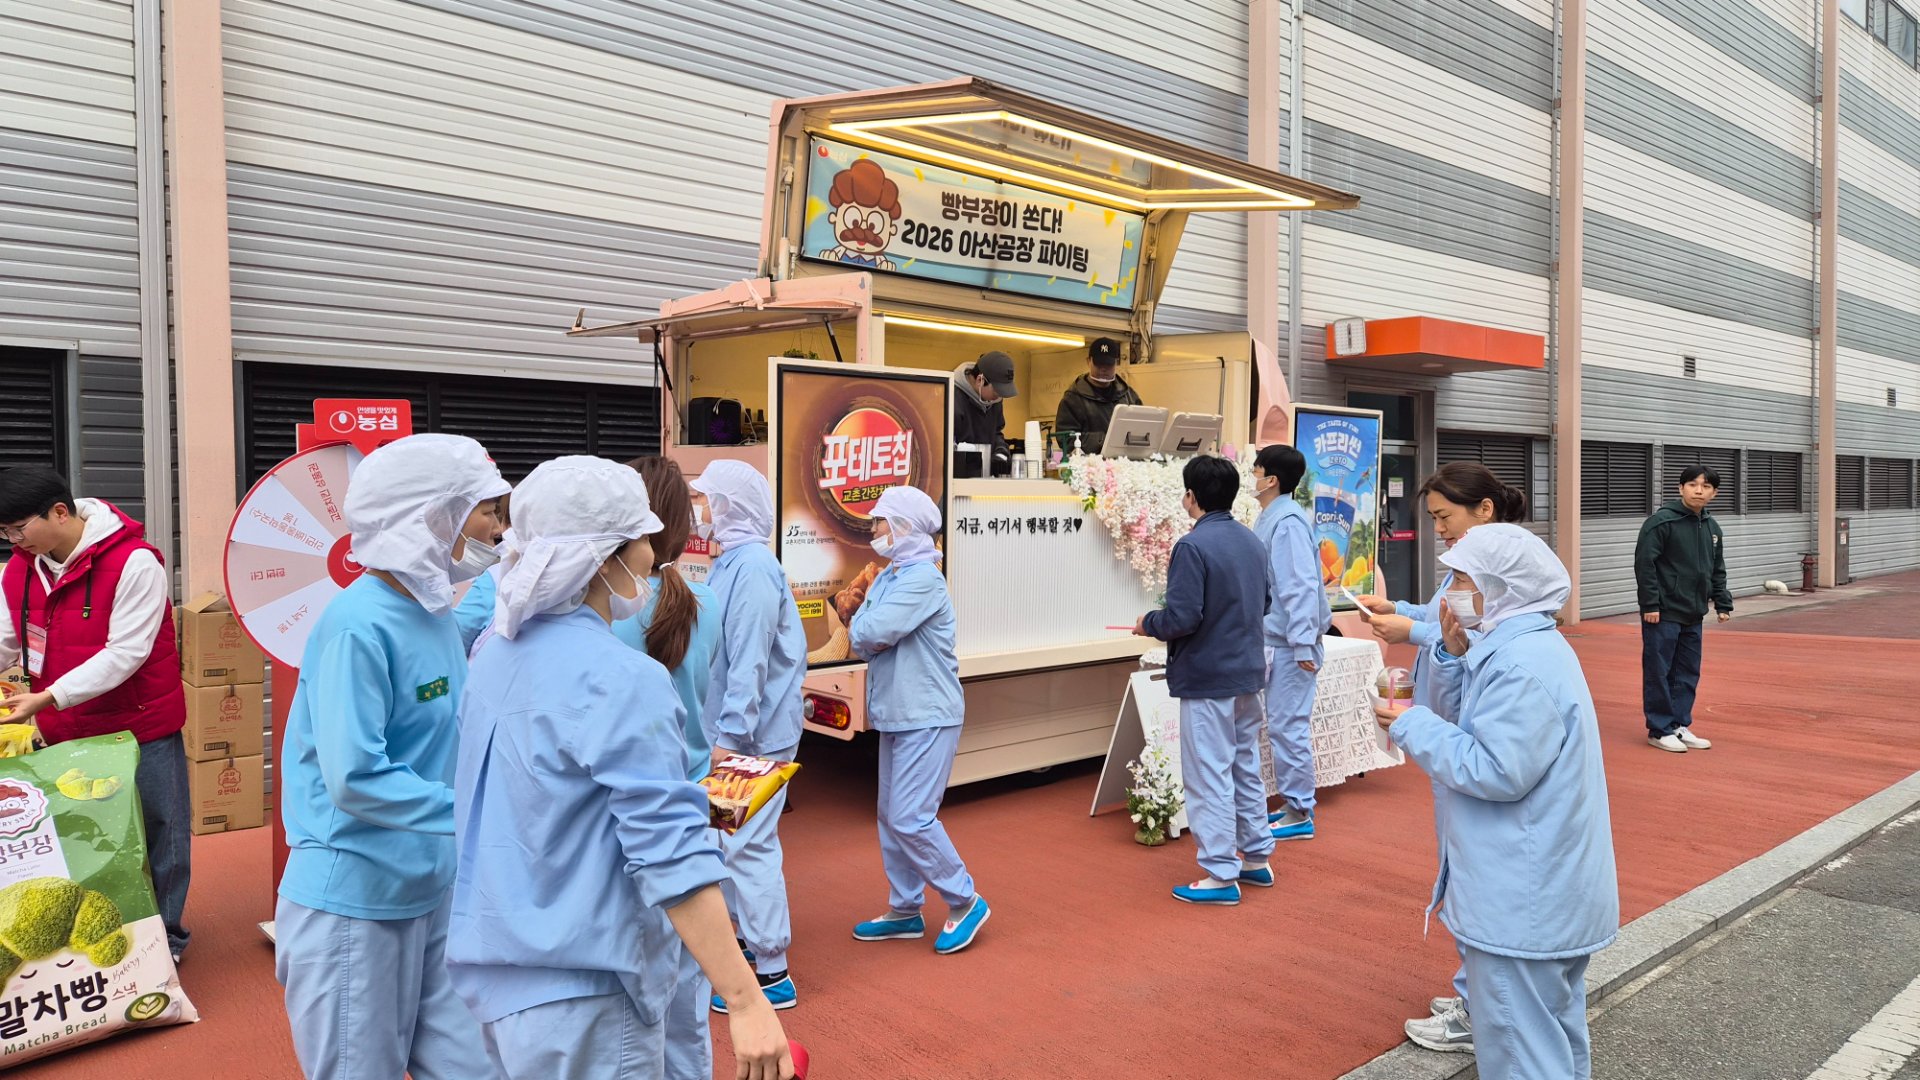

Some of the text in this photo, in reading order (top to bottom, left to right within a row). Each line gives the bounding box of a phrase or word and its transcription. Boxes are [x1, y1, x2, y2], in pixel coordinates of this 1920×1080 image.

[941, 190, 1063, 233] 빵부장이 쏜다!
[901, 218, 1089, 274] 2026 아산공장 파이팅
[357, 414, 398, 431] 농심
[1313, 431, 1362, 459] 카프리썬
[820, 430, 913, 488] 포테토칩
[1329, 455, 1347, 465] zero
[842, 487, 861, 502] 교촌
[956, 517, 984, 535] 지금,
[987, 517, 1021, 535] 여기서
[1026, 516, 1059, 534] 행복할
[1316, 511, 1351, 533] Capri-Sun
[267, 567, 285, 578] 한번
[797, 602, 821, 610] YOCHON
[8, 674, 19, 682] 50
[112, 981, 138, 1001] 스낵
[0, 971, 109, 1040] 말차빵
[4, 1032, 60, 1056] Matcha
[65, 1013, 108, 1036] Bread
